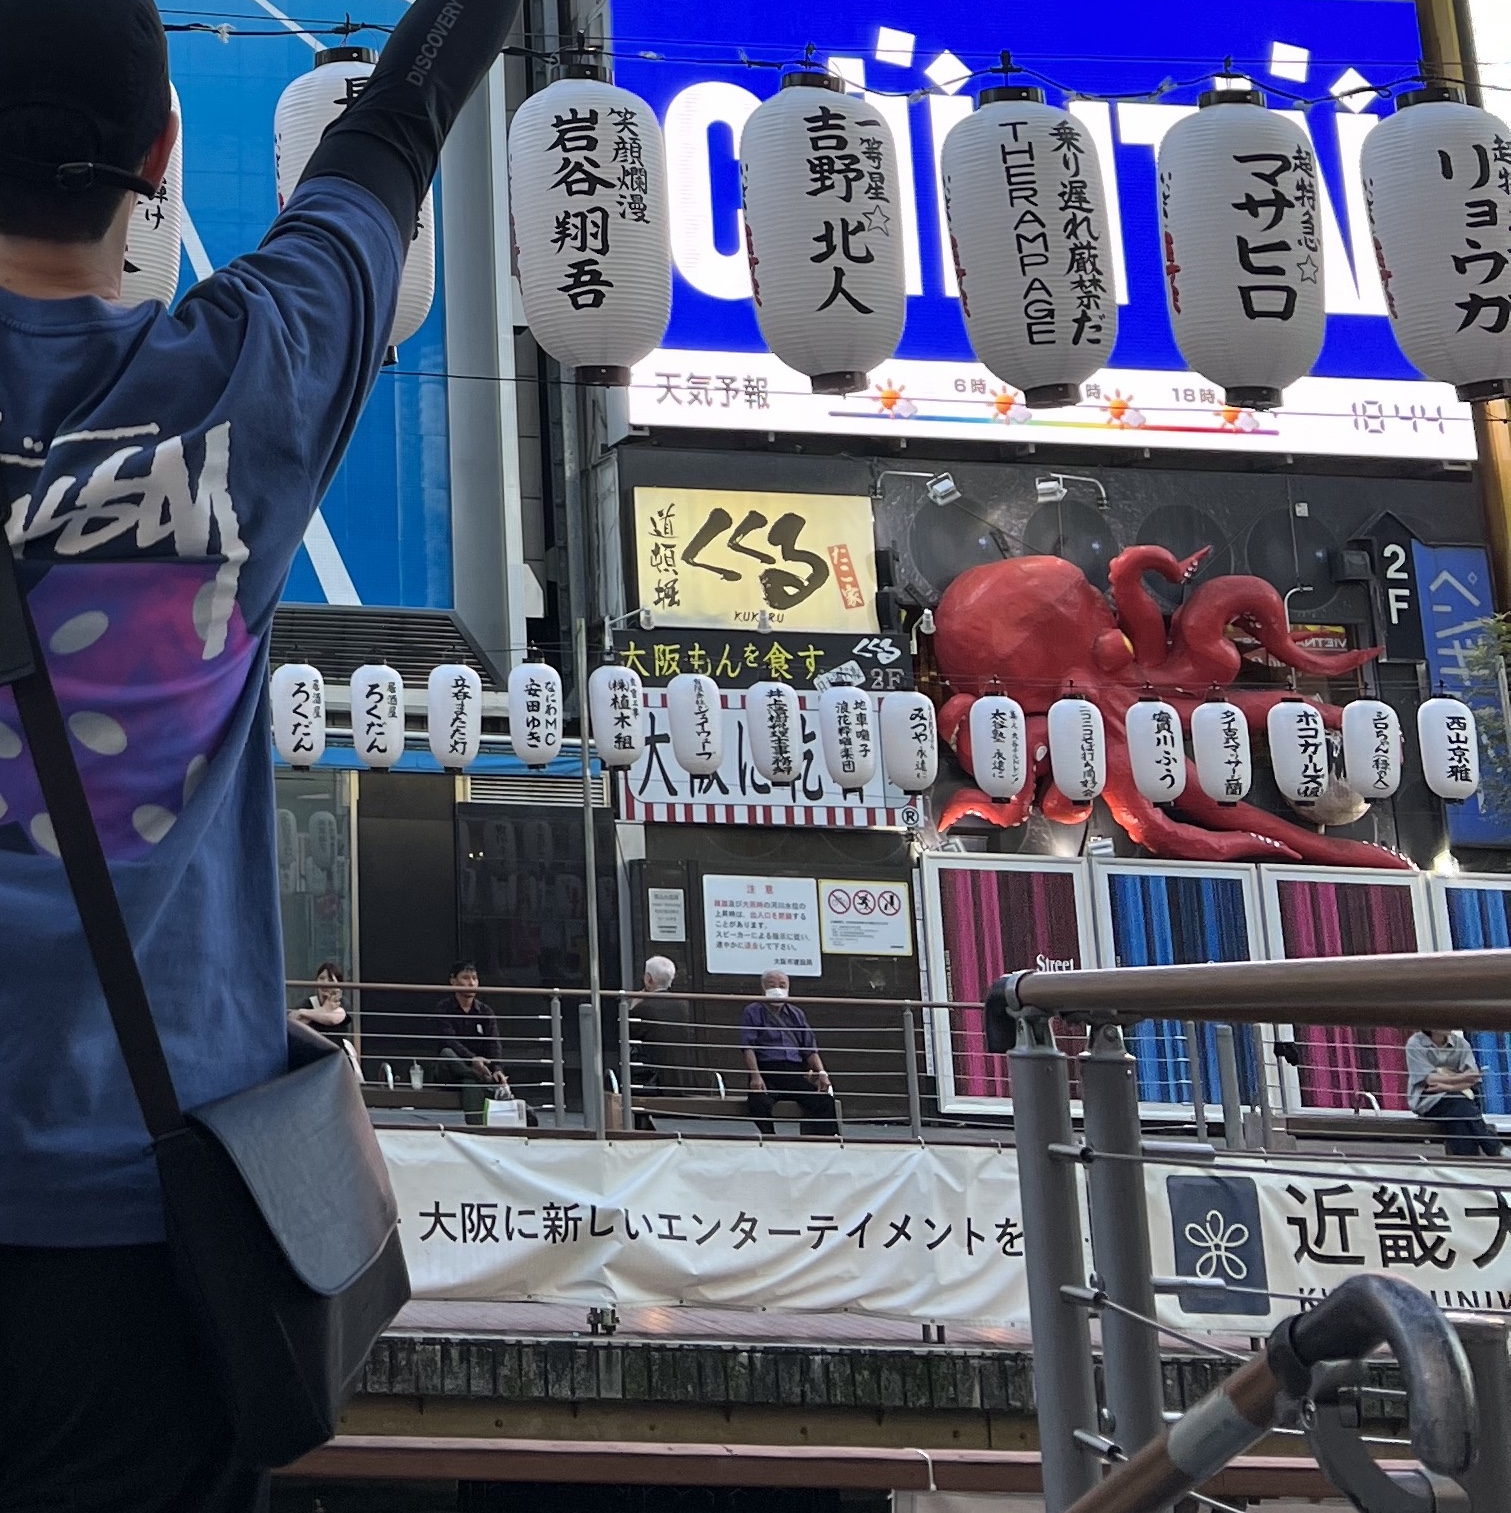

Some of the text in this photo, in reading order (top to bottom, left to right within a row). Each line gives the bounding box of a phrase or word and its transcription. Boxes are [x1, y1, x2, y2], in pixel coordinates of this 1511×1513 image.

[606, 106, 651, 225] 笑顔爛漫
[1048, 119, 1108, 346] 乗り遅れ厳禁だ
[1230, 152, 1298, 322] マサヒロ
[655, 372, 770, 410] 天気予報
[1172, 386, 1216, 405] 18時
[649, 503, 682, 610] 道頓堀
[680, 507, 830, 611] くくる
[1383, 544, 1411, 625] 2F
[734, 610, 785, 624] KUKRU
[852, 638, 903, 666] くくる
[619, 639, 826, 681] 大阪もんを食す
[869, 668, 905, 690] 2F
[291, 682, 314, 754] ろくだん
[365, 683, 388, 755] ろくだん
[524, 677, 543, 749] 安田ゆき
[418, 1199, 1025, 1258] 大阪に新しいエンターテイメントを
